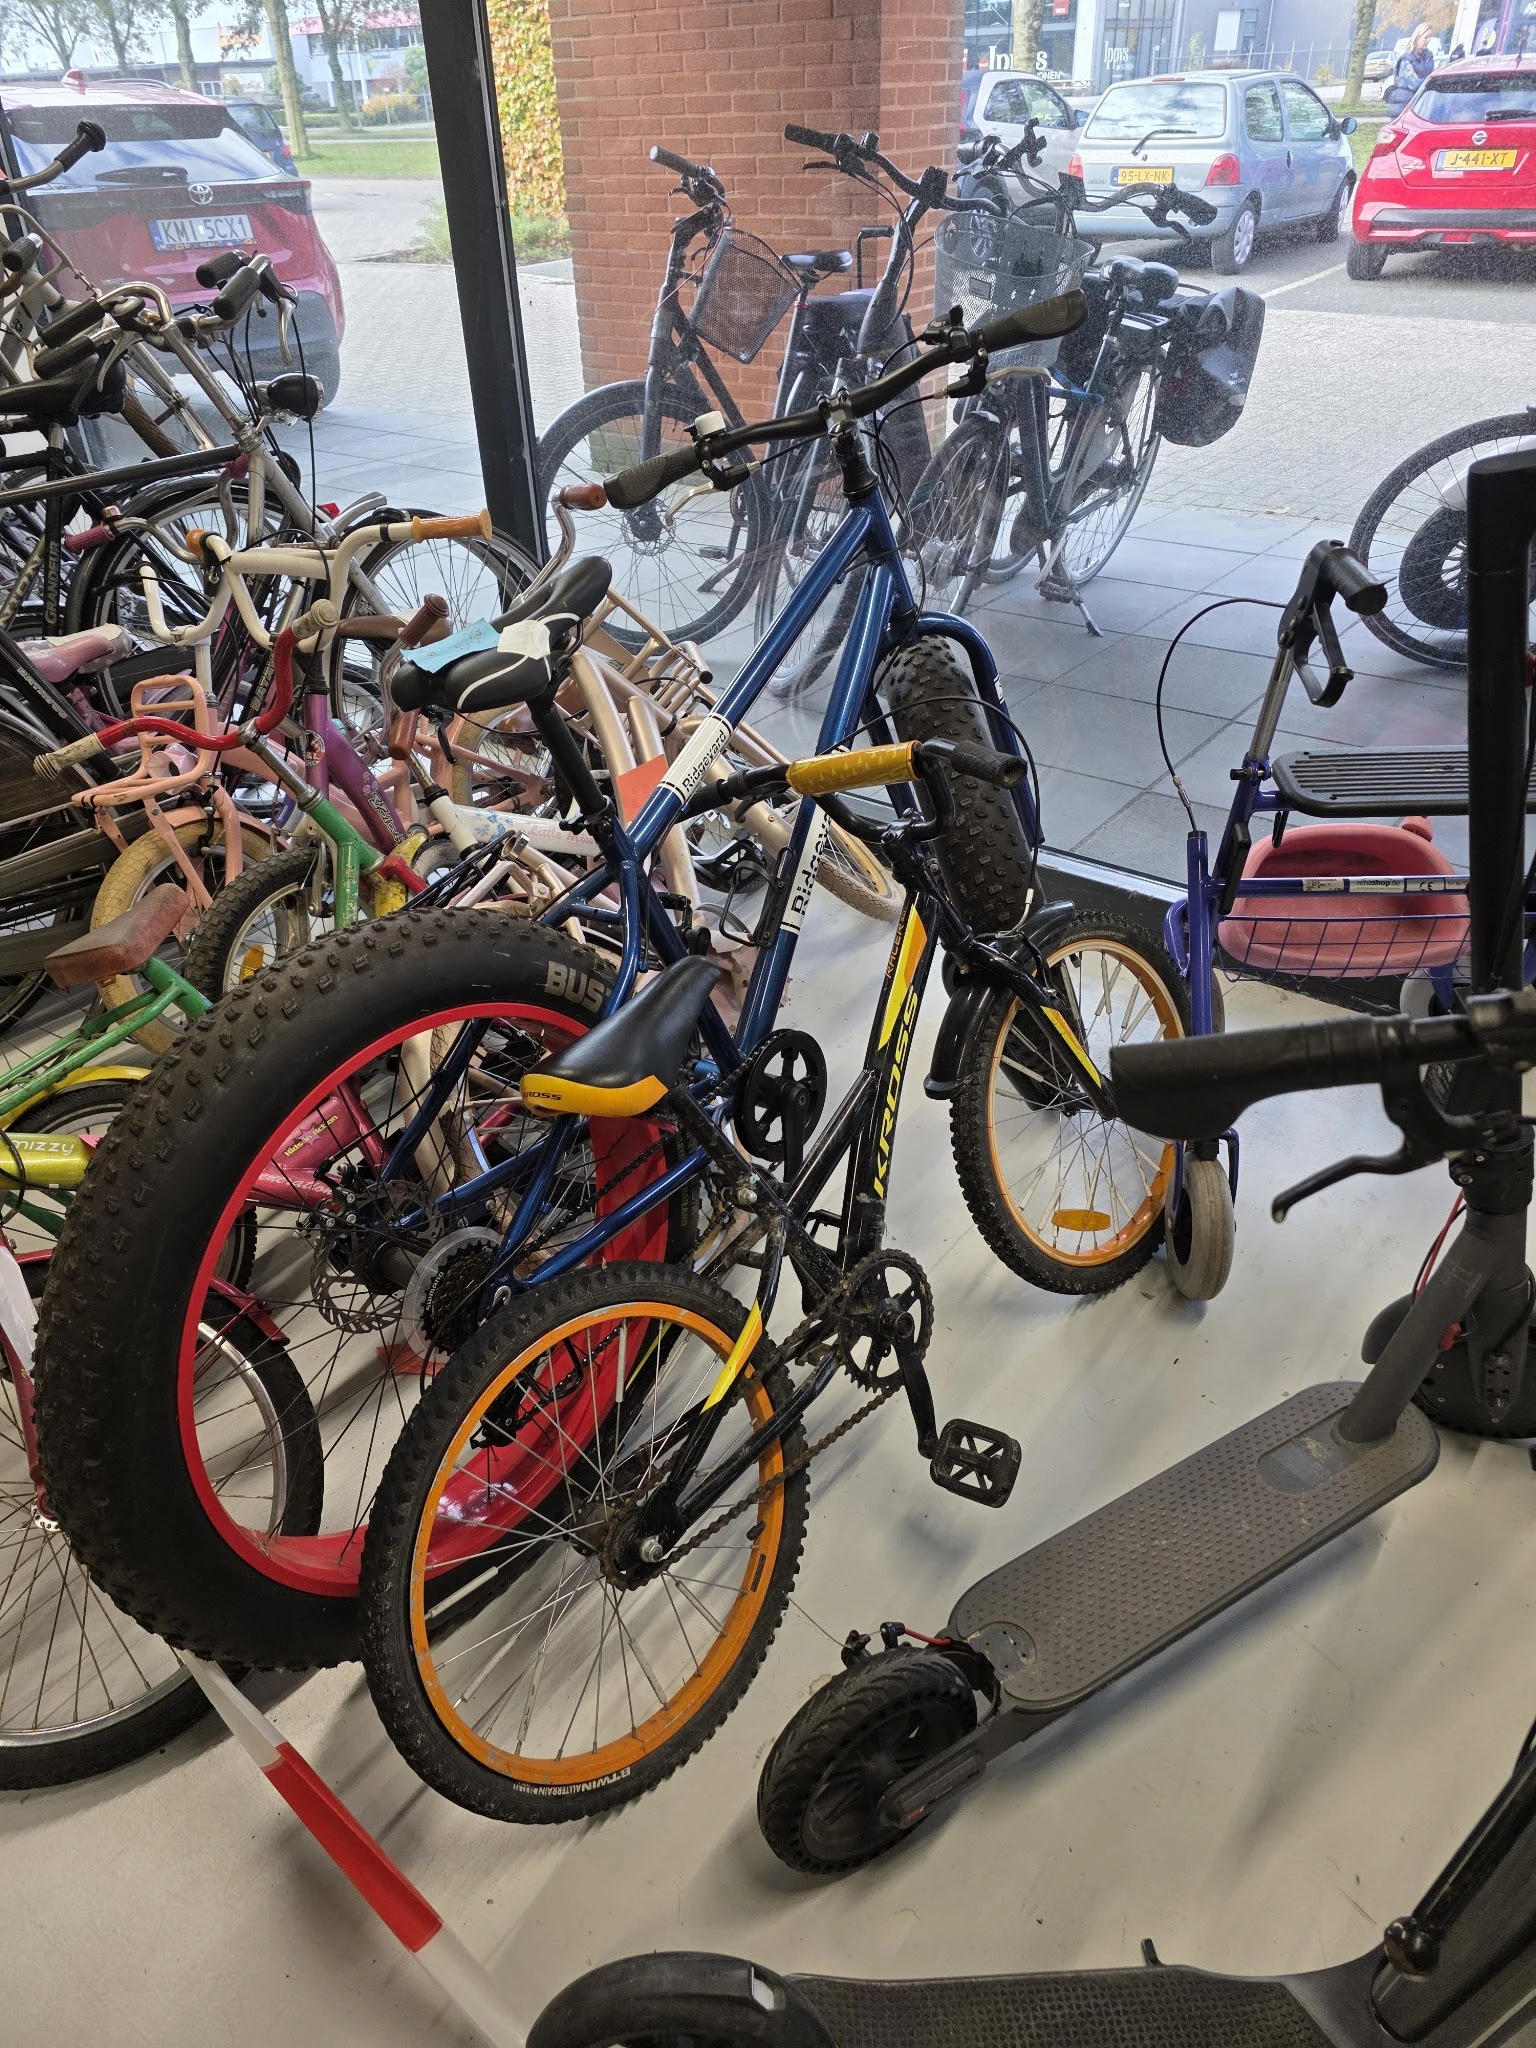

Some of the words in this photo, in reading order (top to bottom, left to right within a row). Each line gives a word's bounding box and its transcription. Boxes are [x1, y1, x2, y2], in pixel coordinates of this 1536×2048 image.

[988, 45, 1048, 70] Ips
[1104, 41, 1129, 70] Ippys
[1121, 170, 1170, 182] 95-LX-NK
[1450, 152, 1509, 166] J-441-XT
[204, 217, 248, 240] 5CX1
[44, 540, 61, 625] GRANDEUR
[17, 666, 68, 719] BATAVUS
[681, 729, 728, 793] Ridgeyard
[528, 825, 562, 840] Little
[885, 921, 905, 978] RACER
[544, 960, 612, 1013] BUS
[523, 1091, 562, 1101] KROSS
[873, 992, 918, 1199] KROSS
[284, 1141, 304, 1157] Kids
[303, 1134, 314, 1144] in
[312, 1115, 338, 1136] Action
